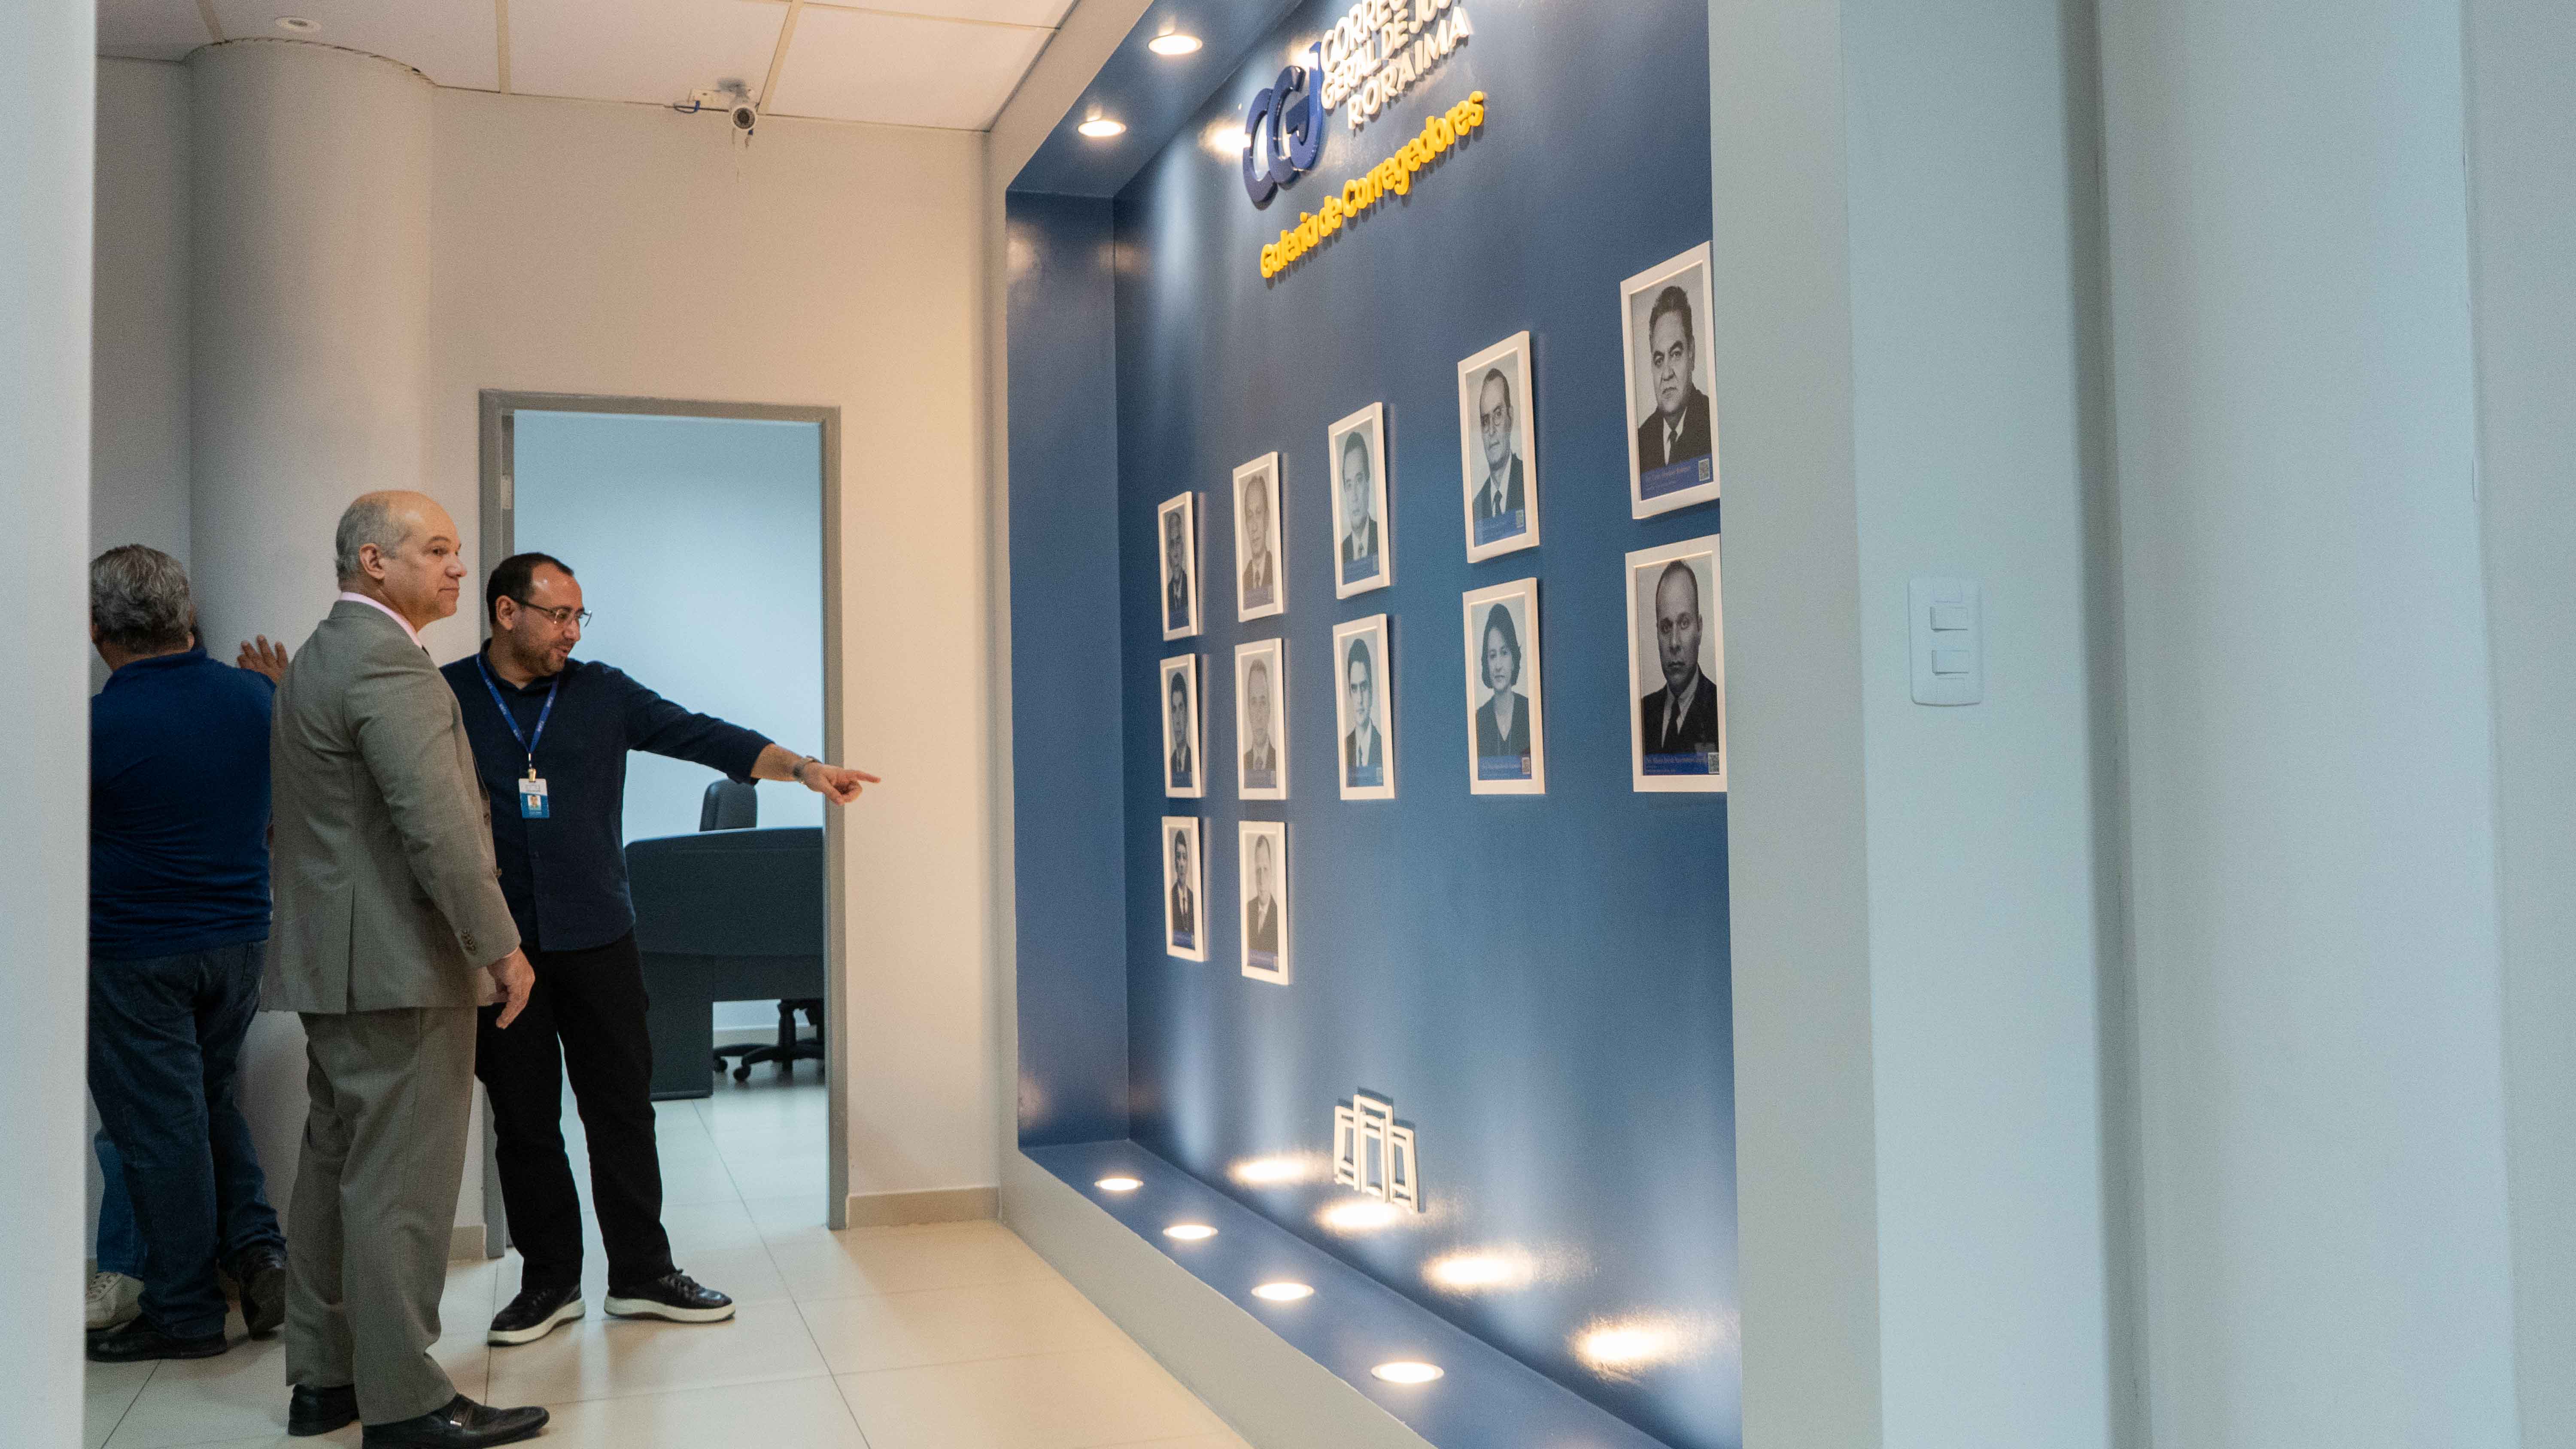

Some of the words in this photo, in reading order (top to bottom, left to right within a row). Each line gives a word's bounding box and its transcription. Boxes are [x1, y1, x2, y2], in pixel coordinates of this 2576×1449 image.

[1320, 0, 1406, 73] CORRE
[1321, 39, 1382, 109] GERAL
[1381, 9, 1409, 59] DE
[1408, 0, 1452, 33] JU
[1347, 6, 1470, 129] RORAIMA
[1243, 41, 1322, 203] CGJ
[1261, 212, 1319, 278] Galeria
[1318, 196, 1343, 236] de
[1342, 91, 1484, 217] Corregedores
